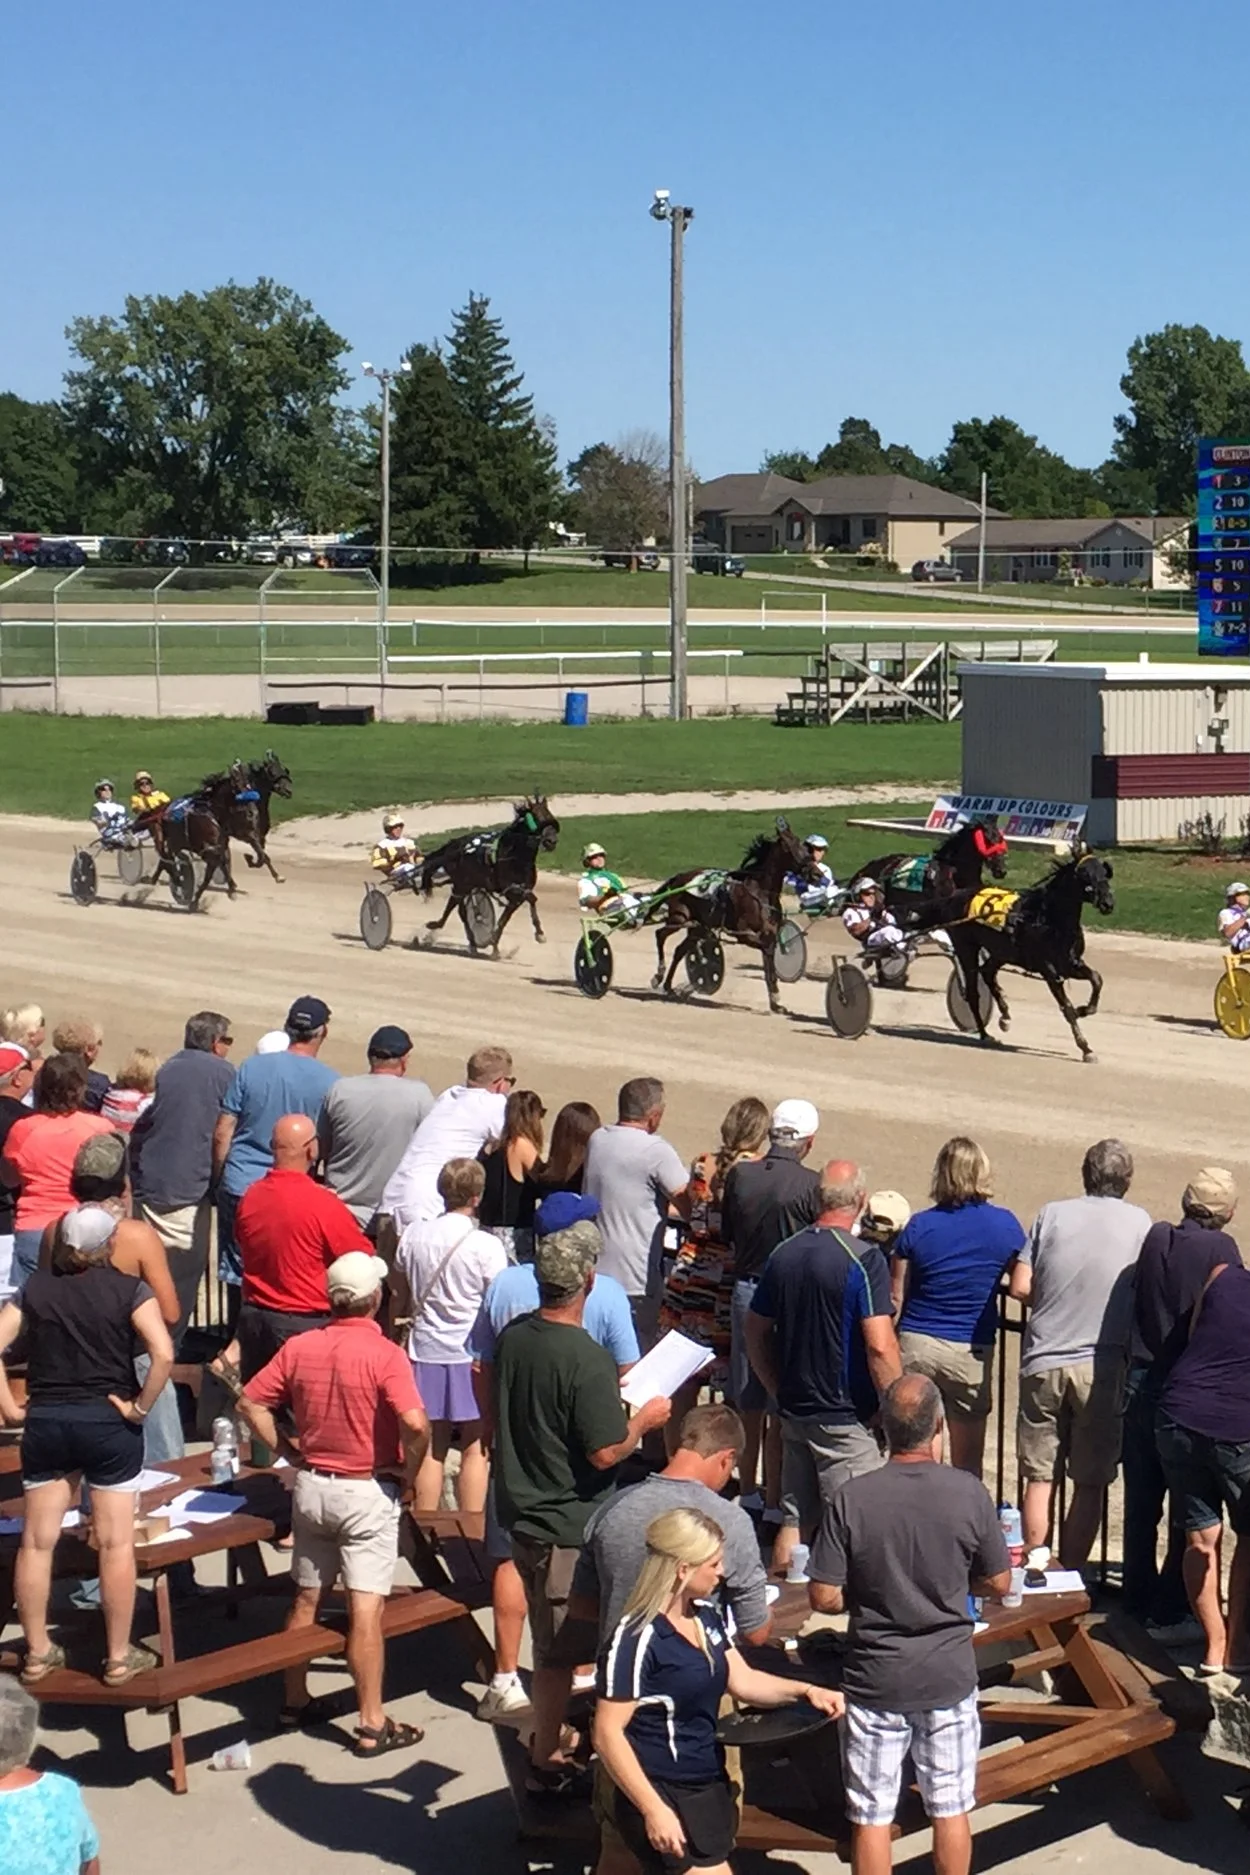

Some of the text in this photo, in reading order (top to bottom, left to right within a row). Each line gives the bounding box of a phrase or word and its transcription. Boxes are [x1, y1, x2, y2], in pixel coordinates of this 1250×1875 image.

[1231, 496, 1245, 508] 10
[1214, 558, 1245, 573] 5 10
[1231, 601, 1243, 613] 11
[1227, 622, 1247, 634] 7-2
[951, 797, 1074, 818] WARM UP COLOURS
[980, 893, 1004, 918] 6
